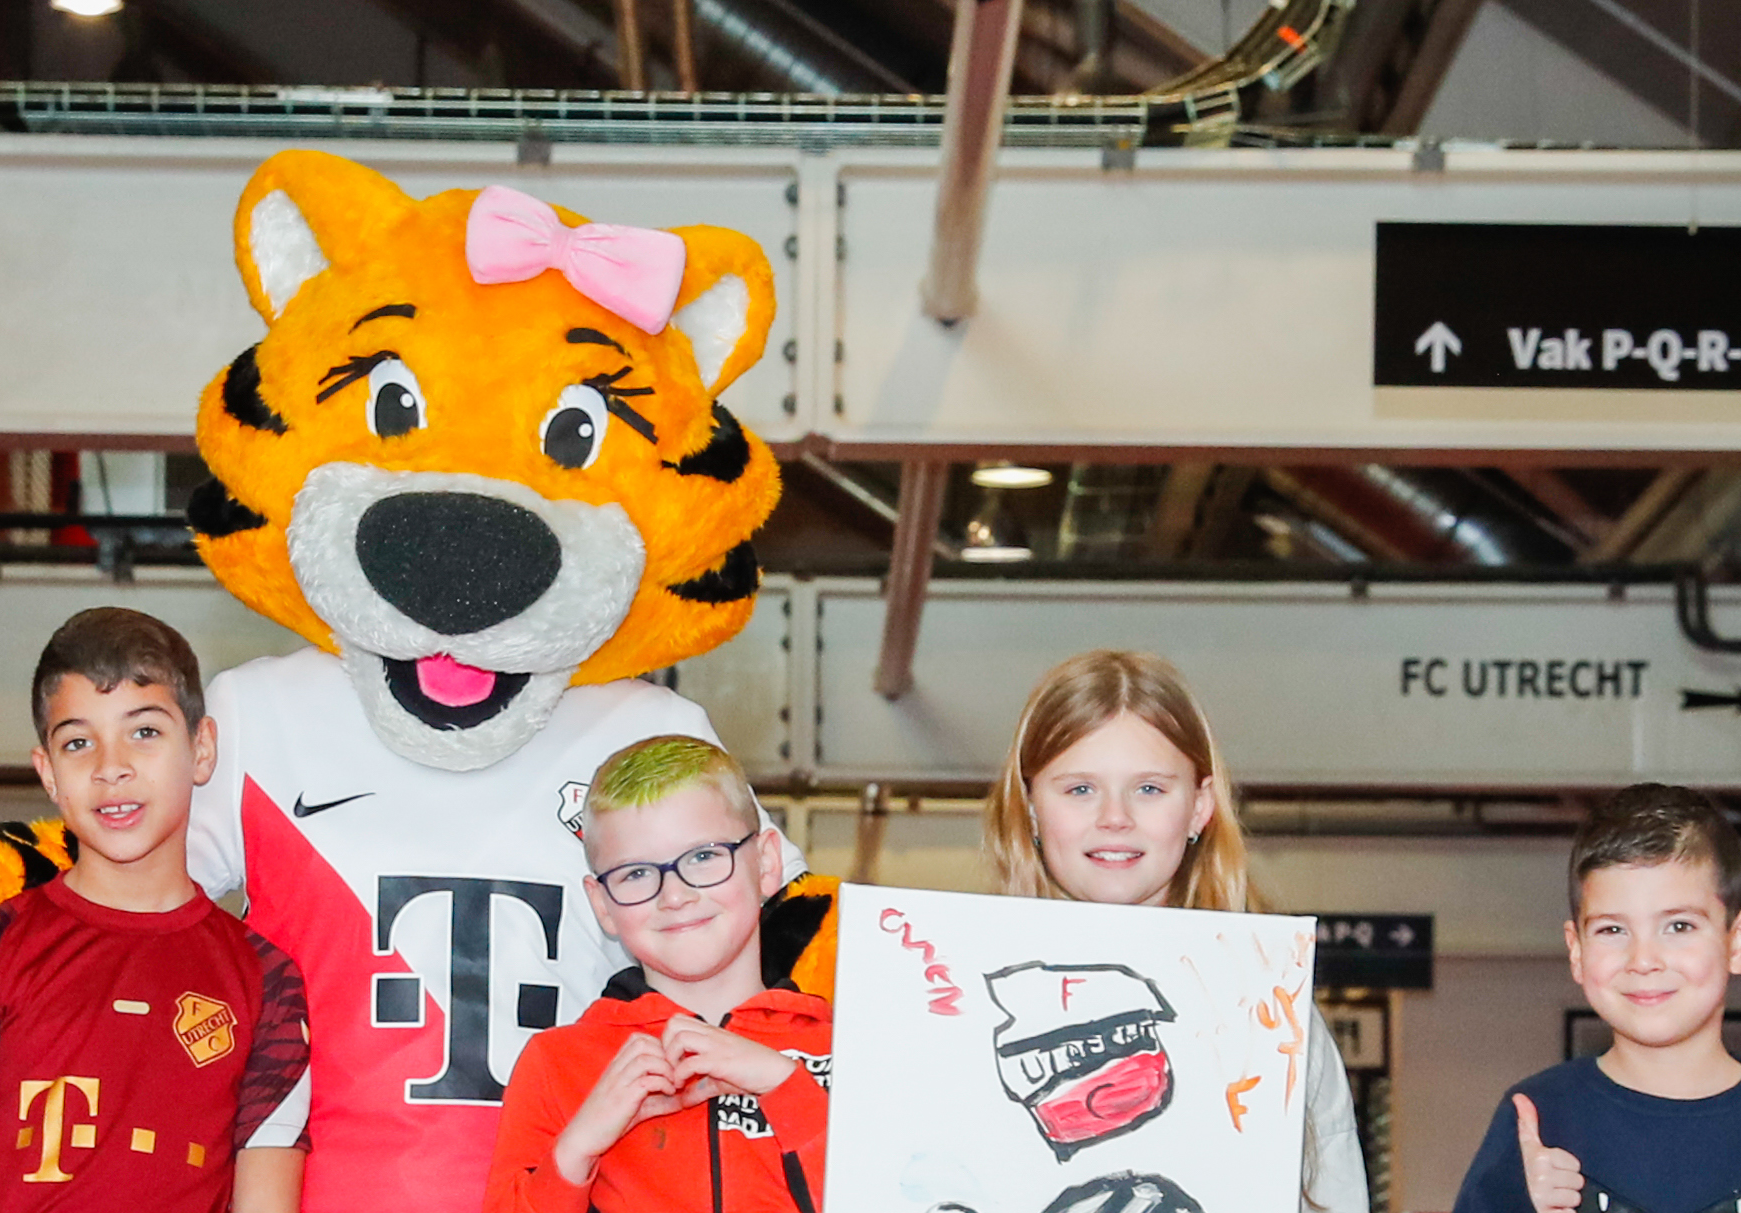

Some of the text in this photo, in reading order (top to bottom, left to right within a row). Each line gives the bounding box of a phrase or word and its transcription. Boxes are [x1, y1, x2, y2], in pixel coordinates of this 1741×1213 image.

[1507, 328, 1592, 370] Vak
[1400, 657, 1651, 699] FC UTRECHT
[1061, 976, 1087, 1012] F
[182, 1010, 230, 1045] UTRECHT
[1086, 1083, 1115, 1120] C
